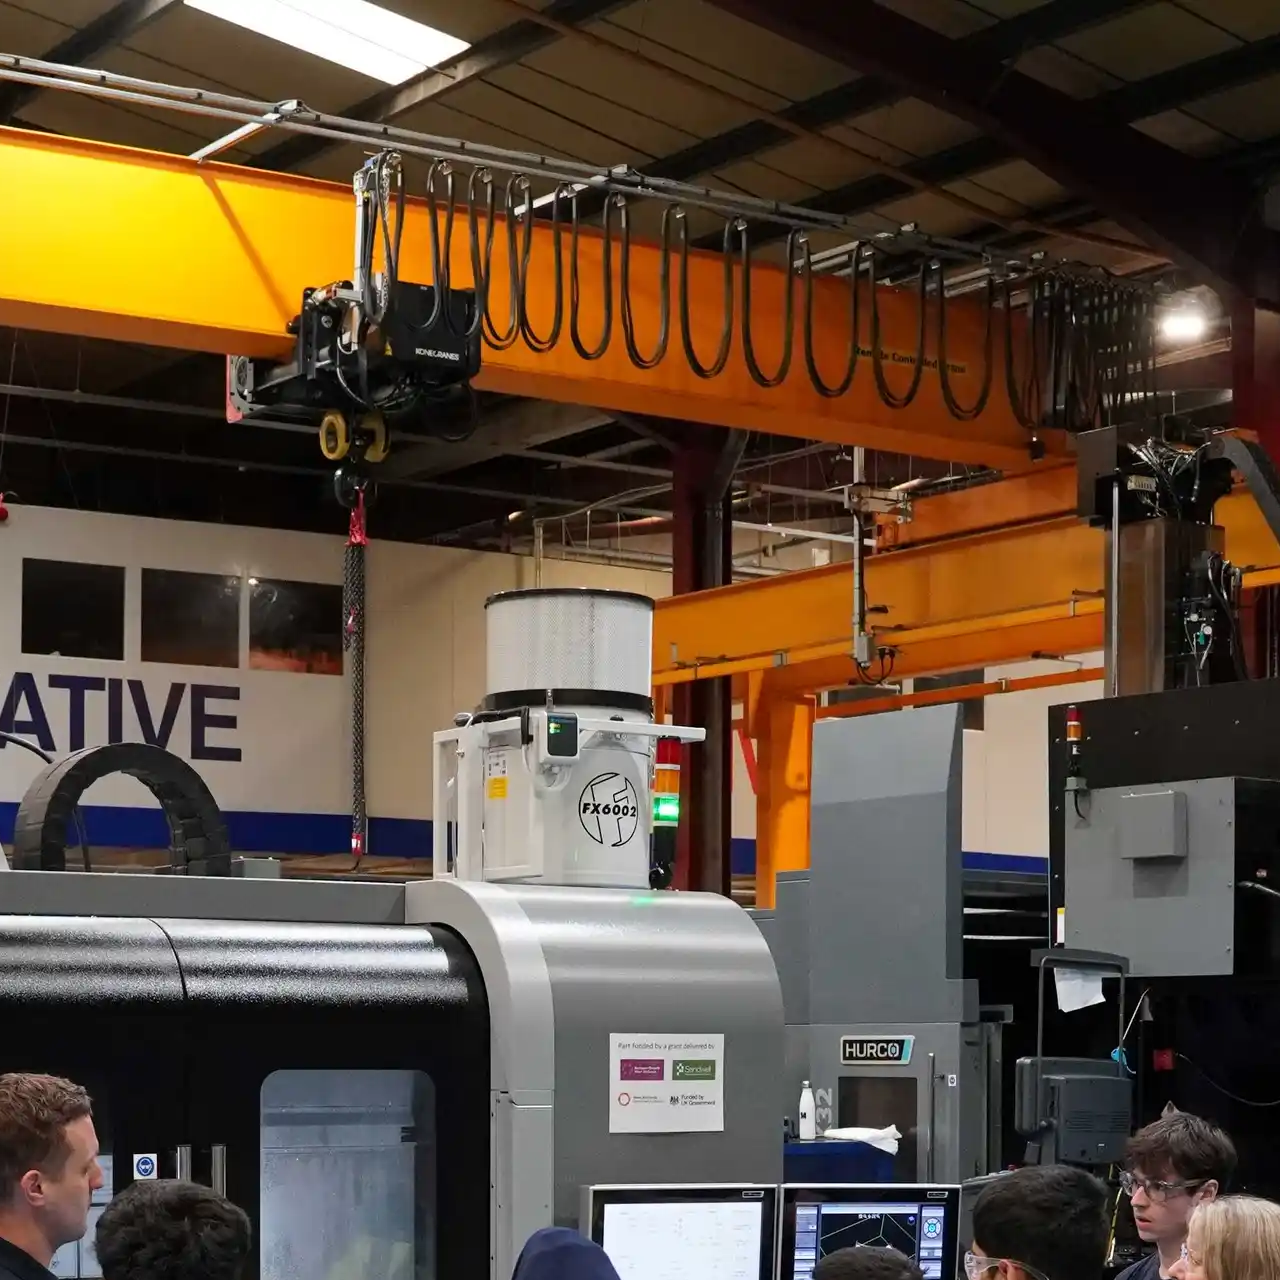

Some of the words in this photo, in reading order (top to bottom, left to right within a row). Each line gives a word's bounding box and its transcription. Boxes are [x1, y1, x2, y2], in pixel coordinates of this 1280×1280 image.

[414, 347, 460, 361] KONECRANES
[582, 802, 637, 818] FX6002
[845, 1042, 900, 1058] HURCO
